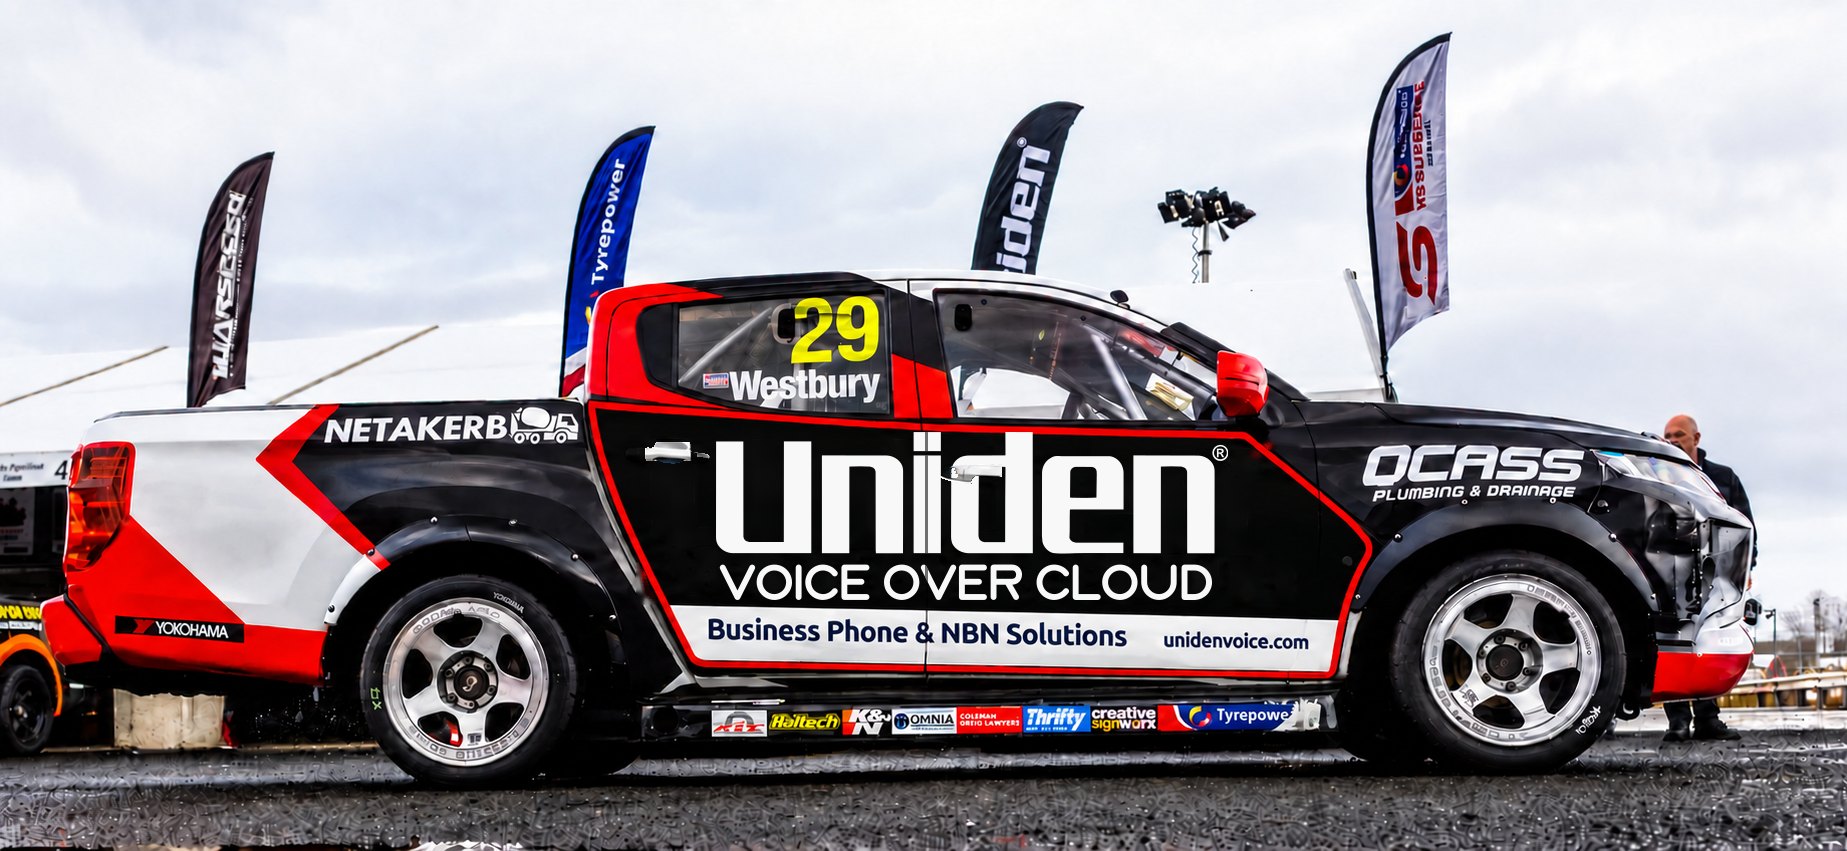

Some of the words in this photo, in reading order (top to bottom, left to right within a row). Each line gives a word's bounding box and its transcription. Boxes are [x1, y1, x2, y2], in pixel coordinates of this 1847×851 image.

[591, 159, 626, 285] Tyrepower
[996, 145, 1051, 273] iden
[791, 296, 880, 364] 29
[729, 369, 881, 404] Westbury
[324, 414, 508, 443] NETAKERB
[1362, 444, 1585, 487] QCASS
[715, 432, 1216, 554] Uniden
[1372, 485, 1465, 502] PLUMBING
[1469, 485, 1481, 497] &
[1486, 485, 1577, 498] DRAINAGE
[719, 564, 870, 601] VOICE
[883, 564, 1023, 601] OVER
[1036, 564, 1214, 601] CLOUD
[155, 620, 230, 639] YOKOHAMA
[708, 617, 821, 642] Business
[827, 618, 909, 643] Phone
[914, 622, 935, 644] &
[941, 622, 1000, 644] NBN
[1006, 622, 1128, 647] Solutions
[1163, 631, 1310, 650] unidenvoice.com
[771, 713, 844, 729] Haltech
[910, 714, 955, 725] OMNIA
[1027, 707, 1087, 732] Thrifty
[1091, 706, 1157, 720] creative
[1091, 718, 1157, 732] signworx
[1216, 708, 1291, 725] Tyrepowe
